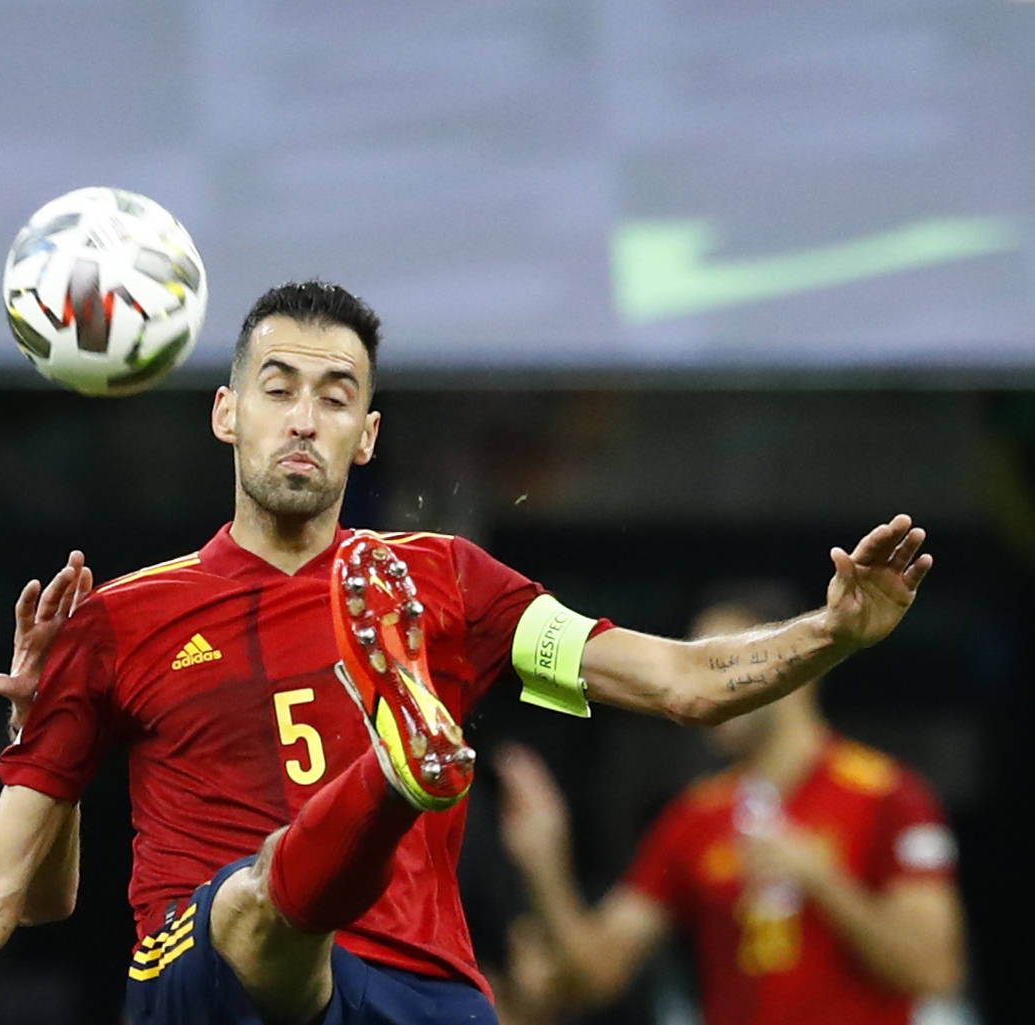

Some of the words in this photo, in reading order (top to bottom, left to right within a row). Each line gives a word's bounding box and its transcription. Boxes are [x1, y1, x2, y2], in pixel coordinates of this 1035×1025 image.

[172, 649, 222, 670] adidas
[539, 611, 567, 669] RESPEC
[274, 688, 326, 785] 5
